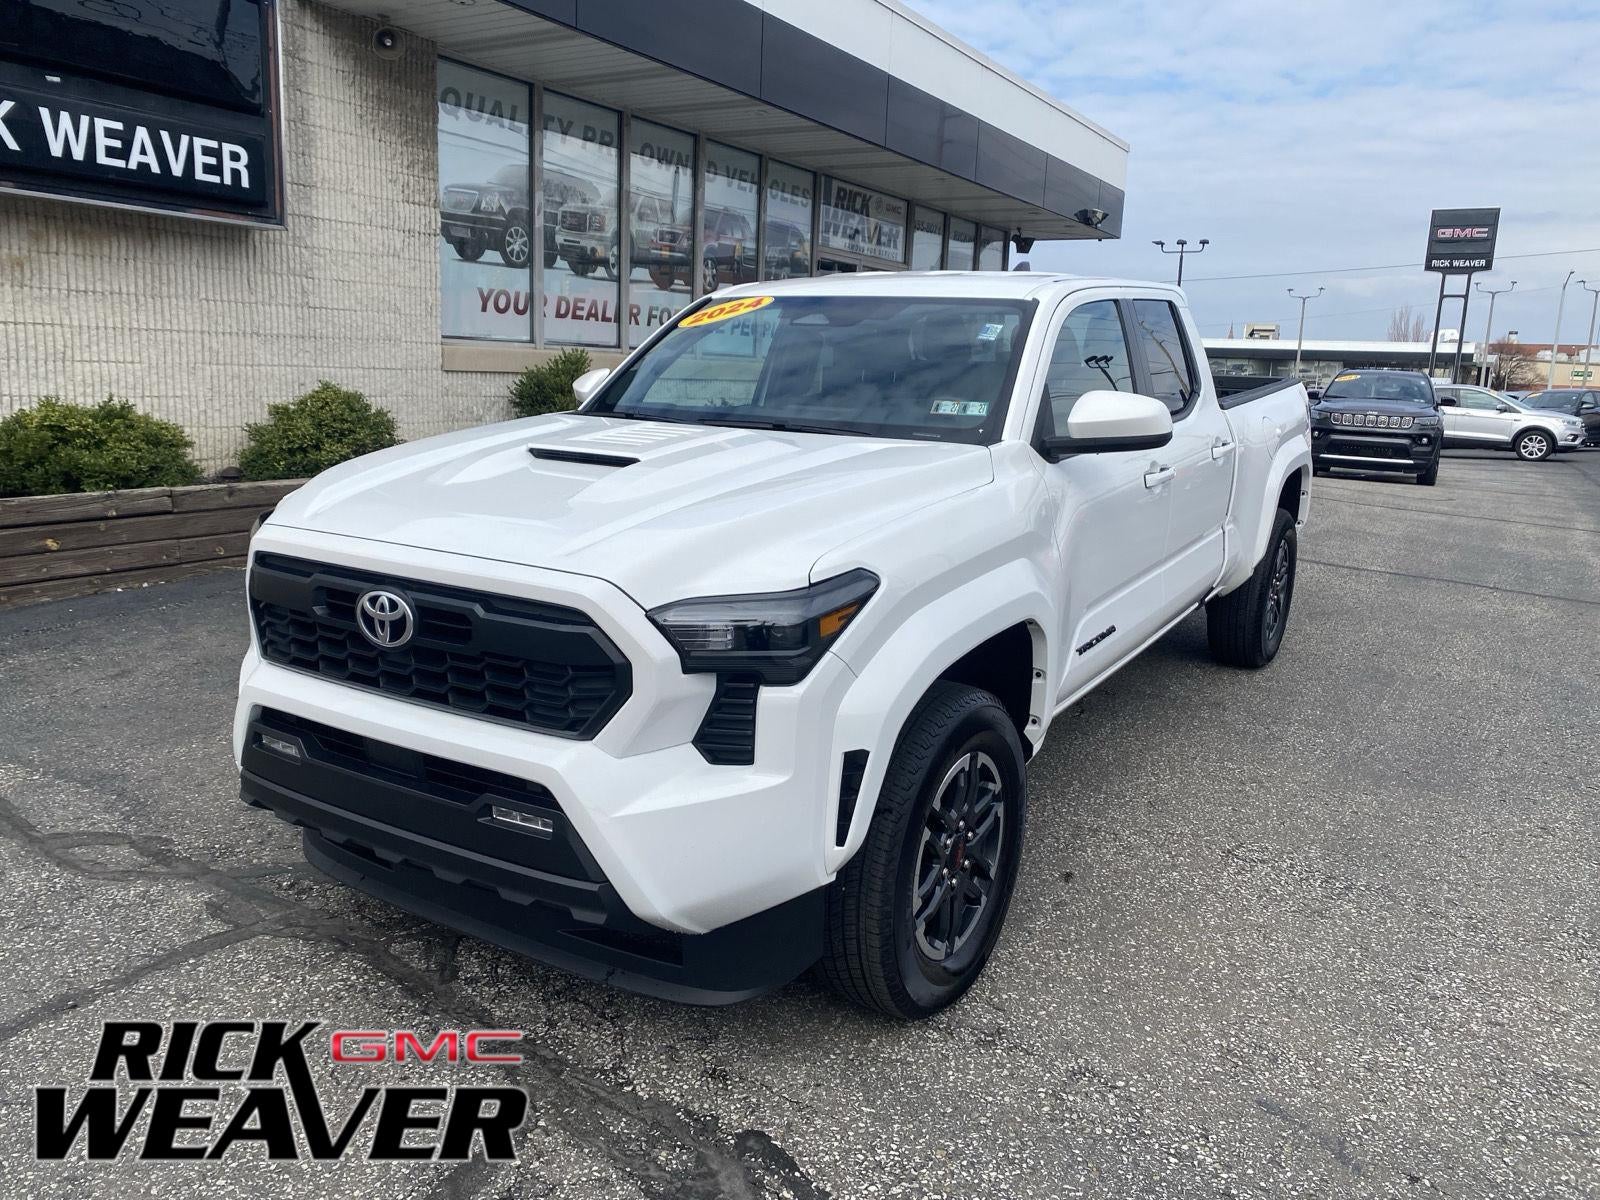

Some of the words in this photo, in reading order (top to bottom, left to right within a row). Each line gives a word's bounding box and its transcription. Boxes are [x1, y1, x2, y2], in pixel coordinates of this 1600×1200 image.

[38, 106, 250, 189] WEAVER
[439, 86, 574, 145] QUALTY
[639, 142, 718, 183] OWND
[725, 164, 811, 208] VECLES
[833, 186, 873, 217] RICK
[1437, 228, 1489, 238] GMC
[1431, 259, 1450, 268] RICK
[1452, 259, 1486, 268] WEAVER
[477, 286, 548, 318] YOU
[647, 306, 682, 327] FO
[687, 296, 766, 327] 2024
